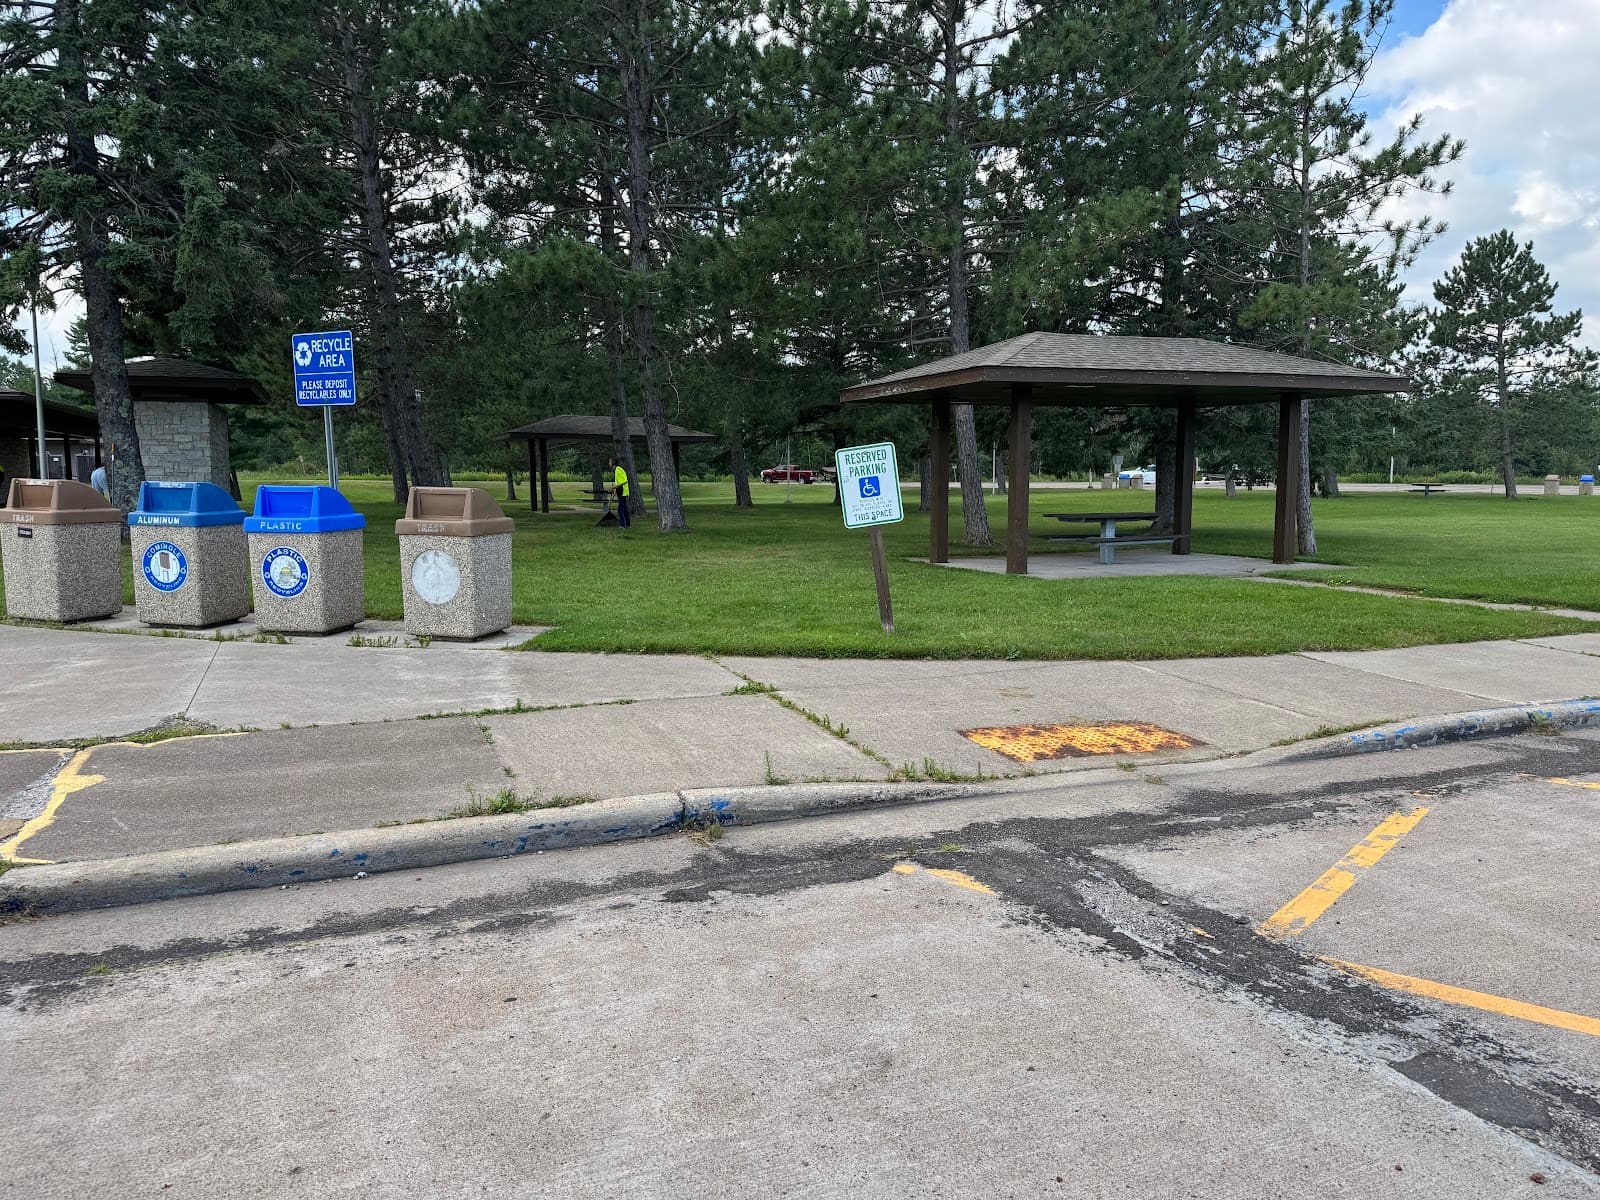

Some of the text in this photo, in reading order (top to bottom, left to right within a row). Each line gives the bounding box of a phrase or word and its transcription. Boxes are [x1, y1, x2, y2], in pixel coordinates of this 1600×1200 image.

[311, 338, 351, 352] RECYCLE
[319, 354, 346, 367] AREA
[302, 380, 348, 390] PLEASE DEPOSIT
[299, 389, 352, 400] RECYCLABLES ONLY
[844, 450, 887, 464] RESERVED
[849, 462, 887, 478] PARKING
[13, 514, 34, 522] TRASH
[138, 516, 180, 524] ALUMINUM
[854, 508, 893, 522] THIS SPACE
[260, 521, 302, 530] PLASTIC
[147, 542, 183, 558] COMINGLE
[267, 548, 303, 564] PLASTIC
